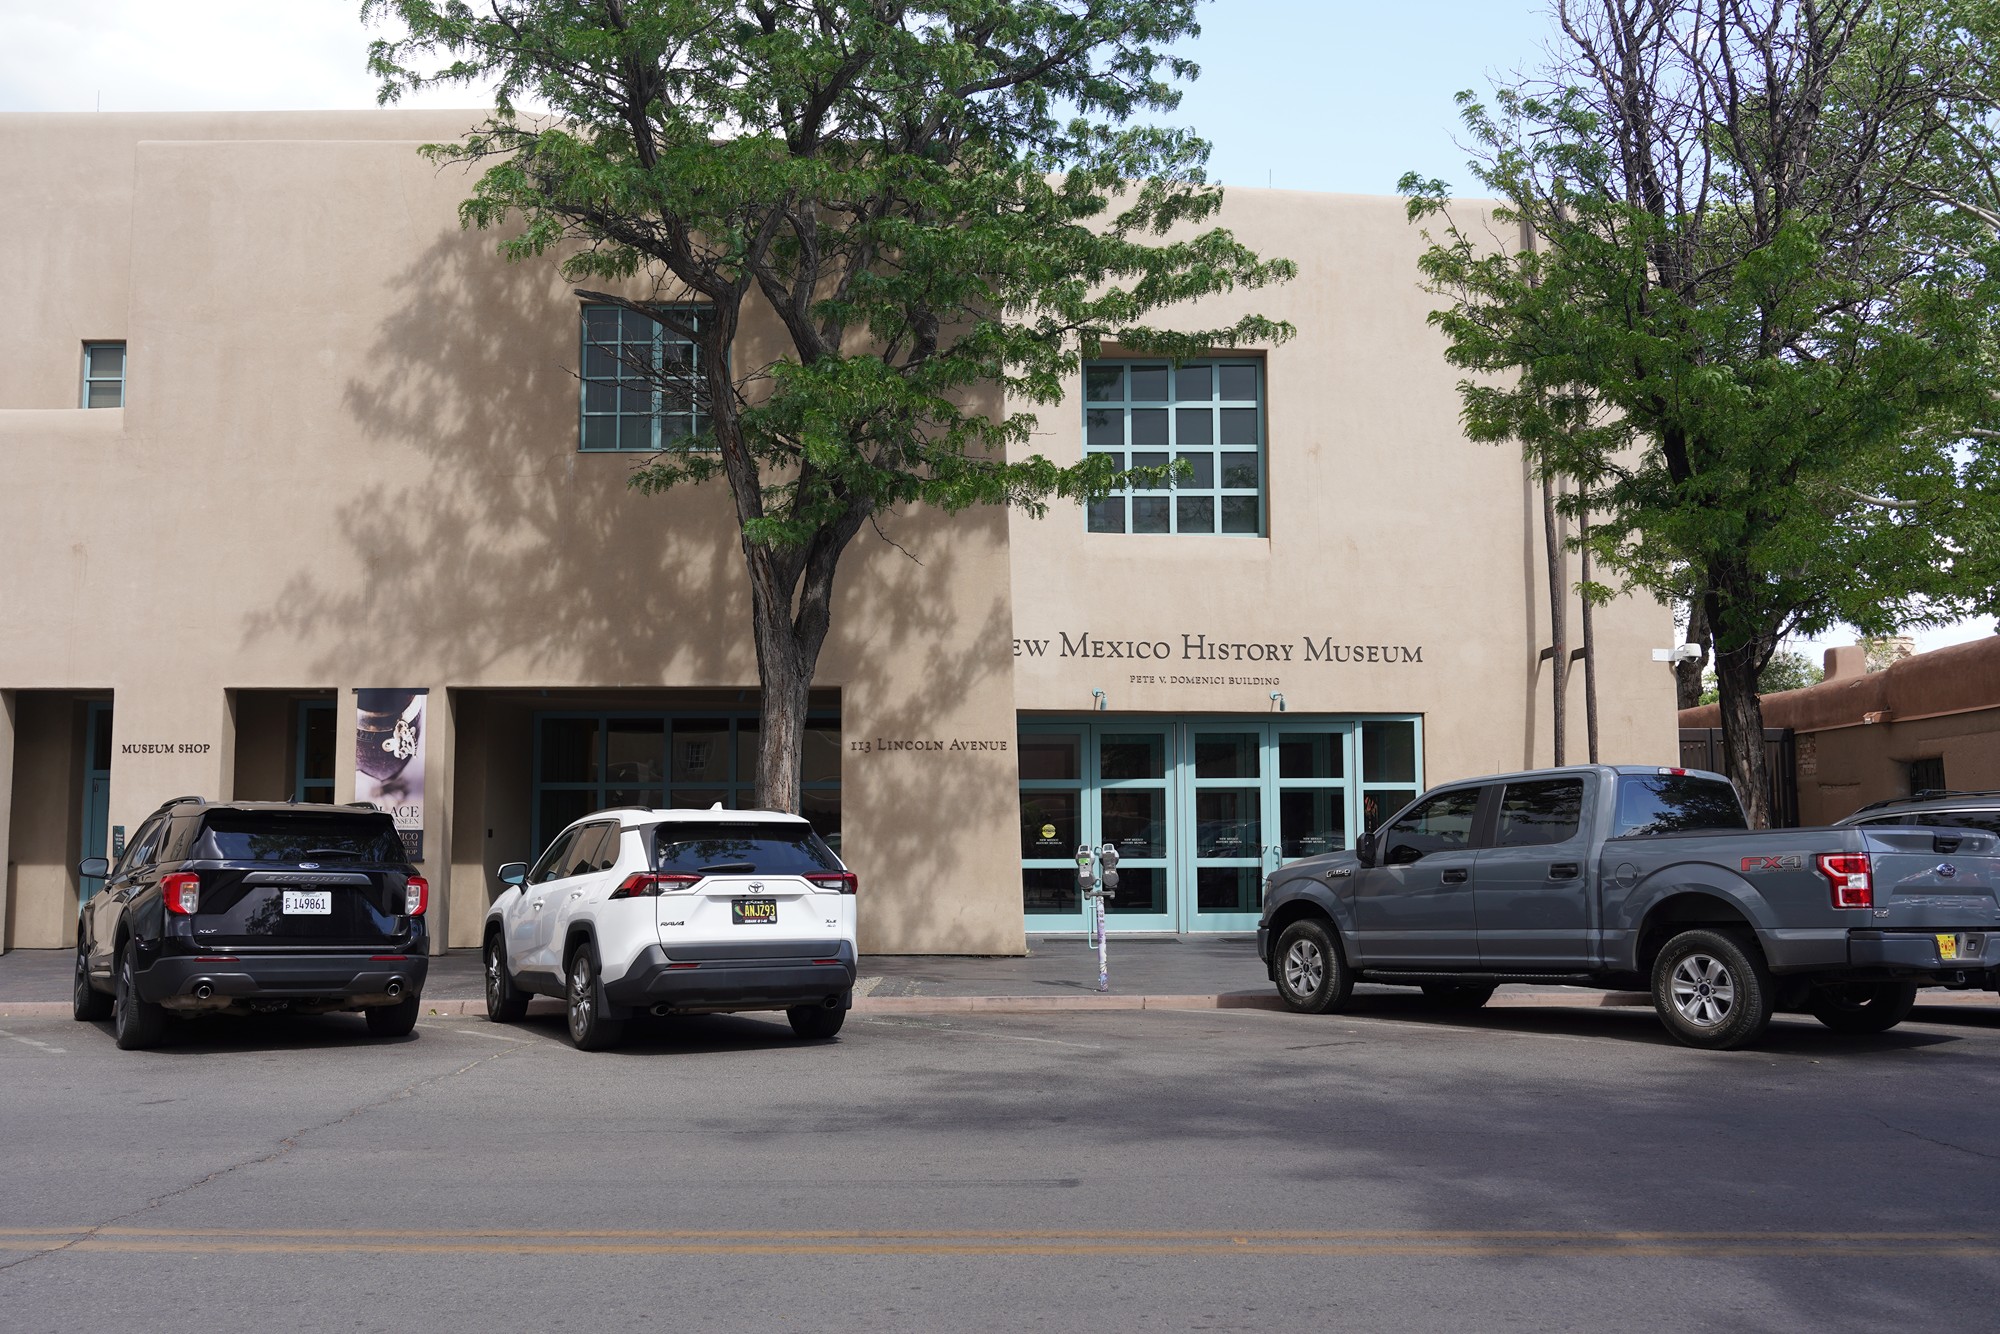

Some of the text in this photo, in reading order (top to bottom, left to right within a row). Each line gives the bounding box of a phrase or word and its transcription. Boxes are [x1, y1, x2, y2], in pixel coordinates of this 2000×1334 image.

[1013, 631, 1424, 663] EW MEXICO HISTORY MUSEUM
[1129, 674, 1280, 686] PETE V. DOMENICI BUILDING
[121, 743, 211, 754] MUSEUM SHOP
[851, 737, 1007, 753] 113 LINCOLN AVENUE
[1740, 855, 1802, 871] FX4
[293, 897, 326, 910] 149861
[744, 904, 775, 917] ANJZ93
